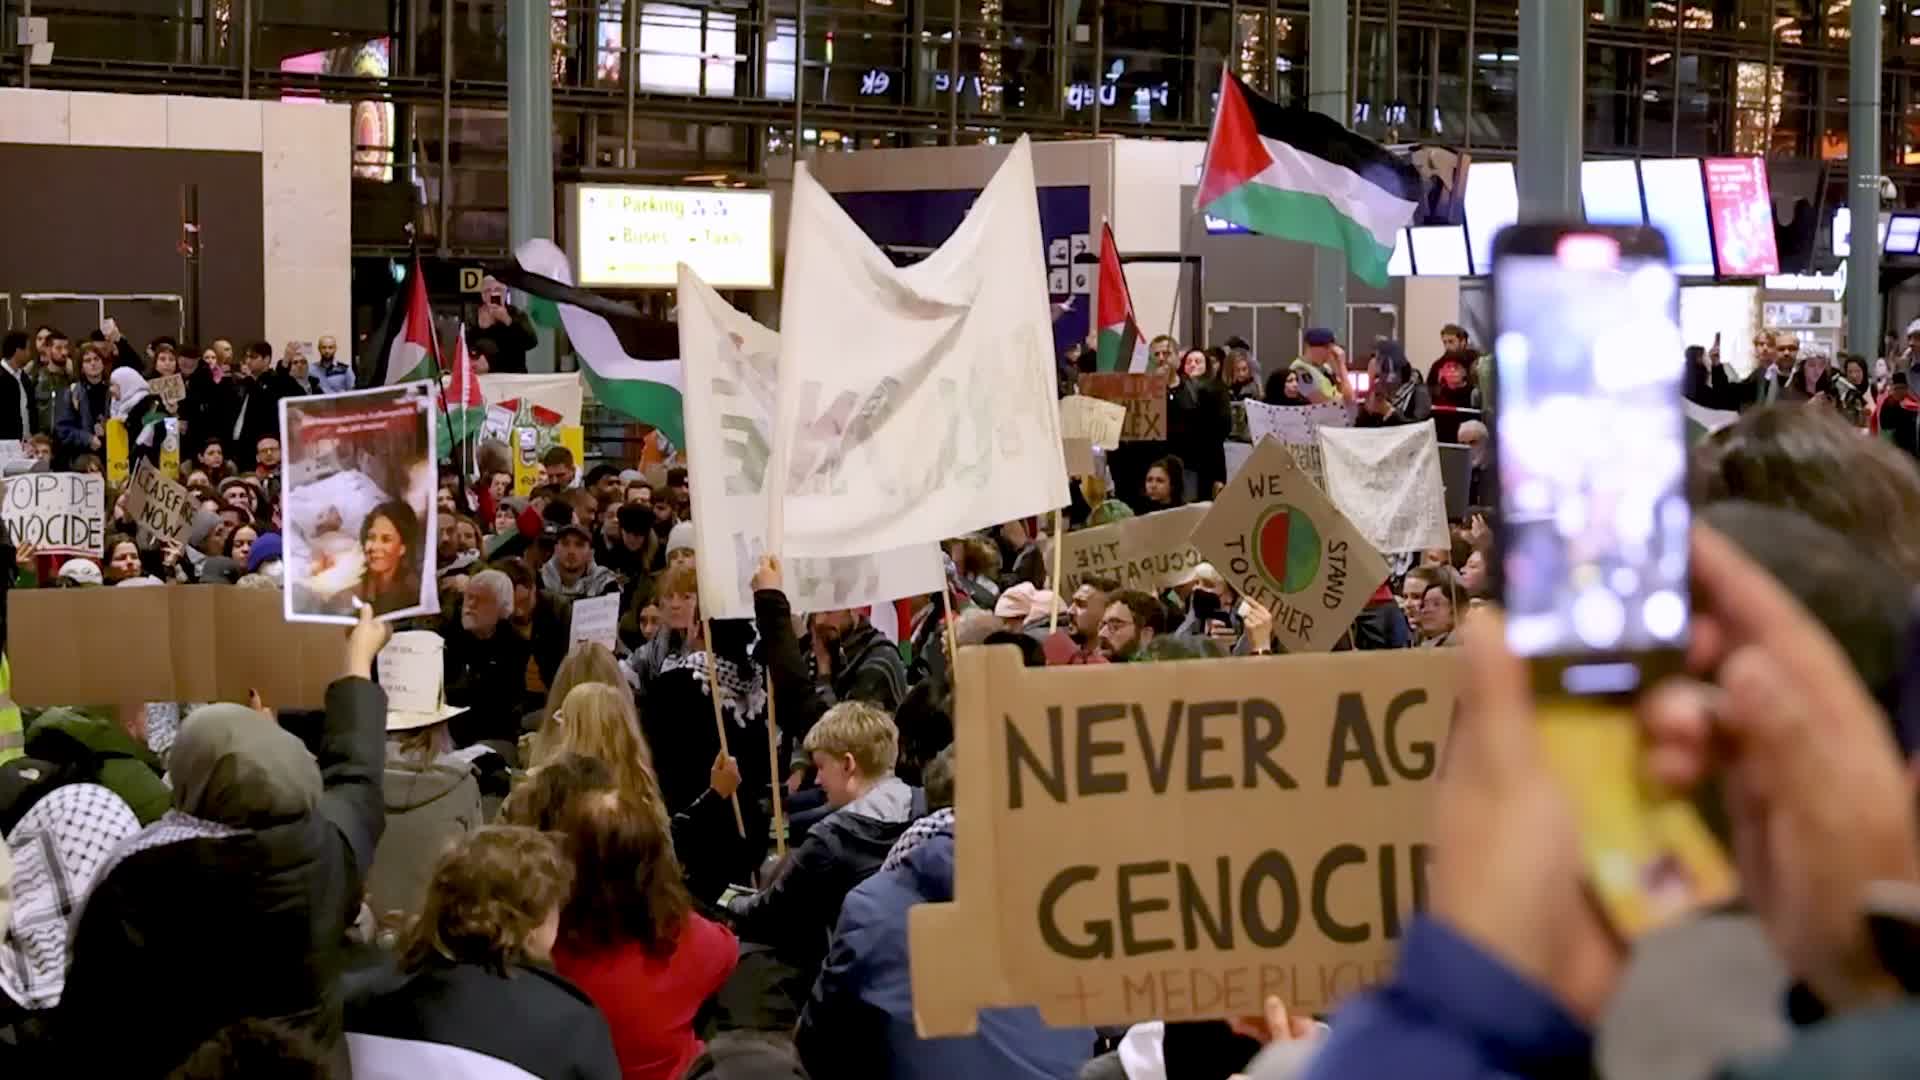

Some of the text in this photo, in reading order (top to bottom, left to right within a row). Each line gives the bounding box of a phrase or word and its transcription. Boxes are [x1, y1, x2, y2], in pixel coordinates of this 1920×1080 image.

[464, 271, 479, 289] D
[70, 476, 100, 509] DE
[1248, 474, 1283, 499] WE
[143, 501, 183, 538] NOW
[1224, 534, 1315, 641] TOGETHER
[1322, 538, 1349, 610] STAND
[1003, 697, 1298, 810] NEVER
